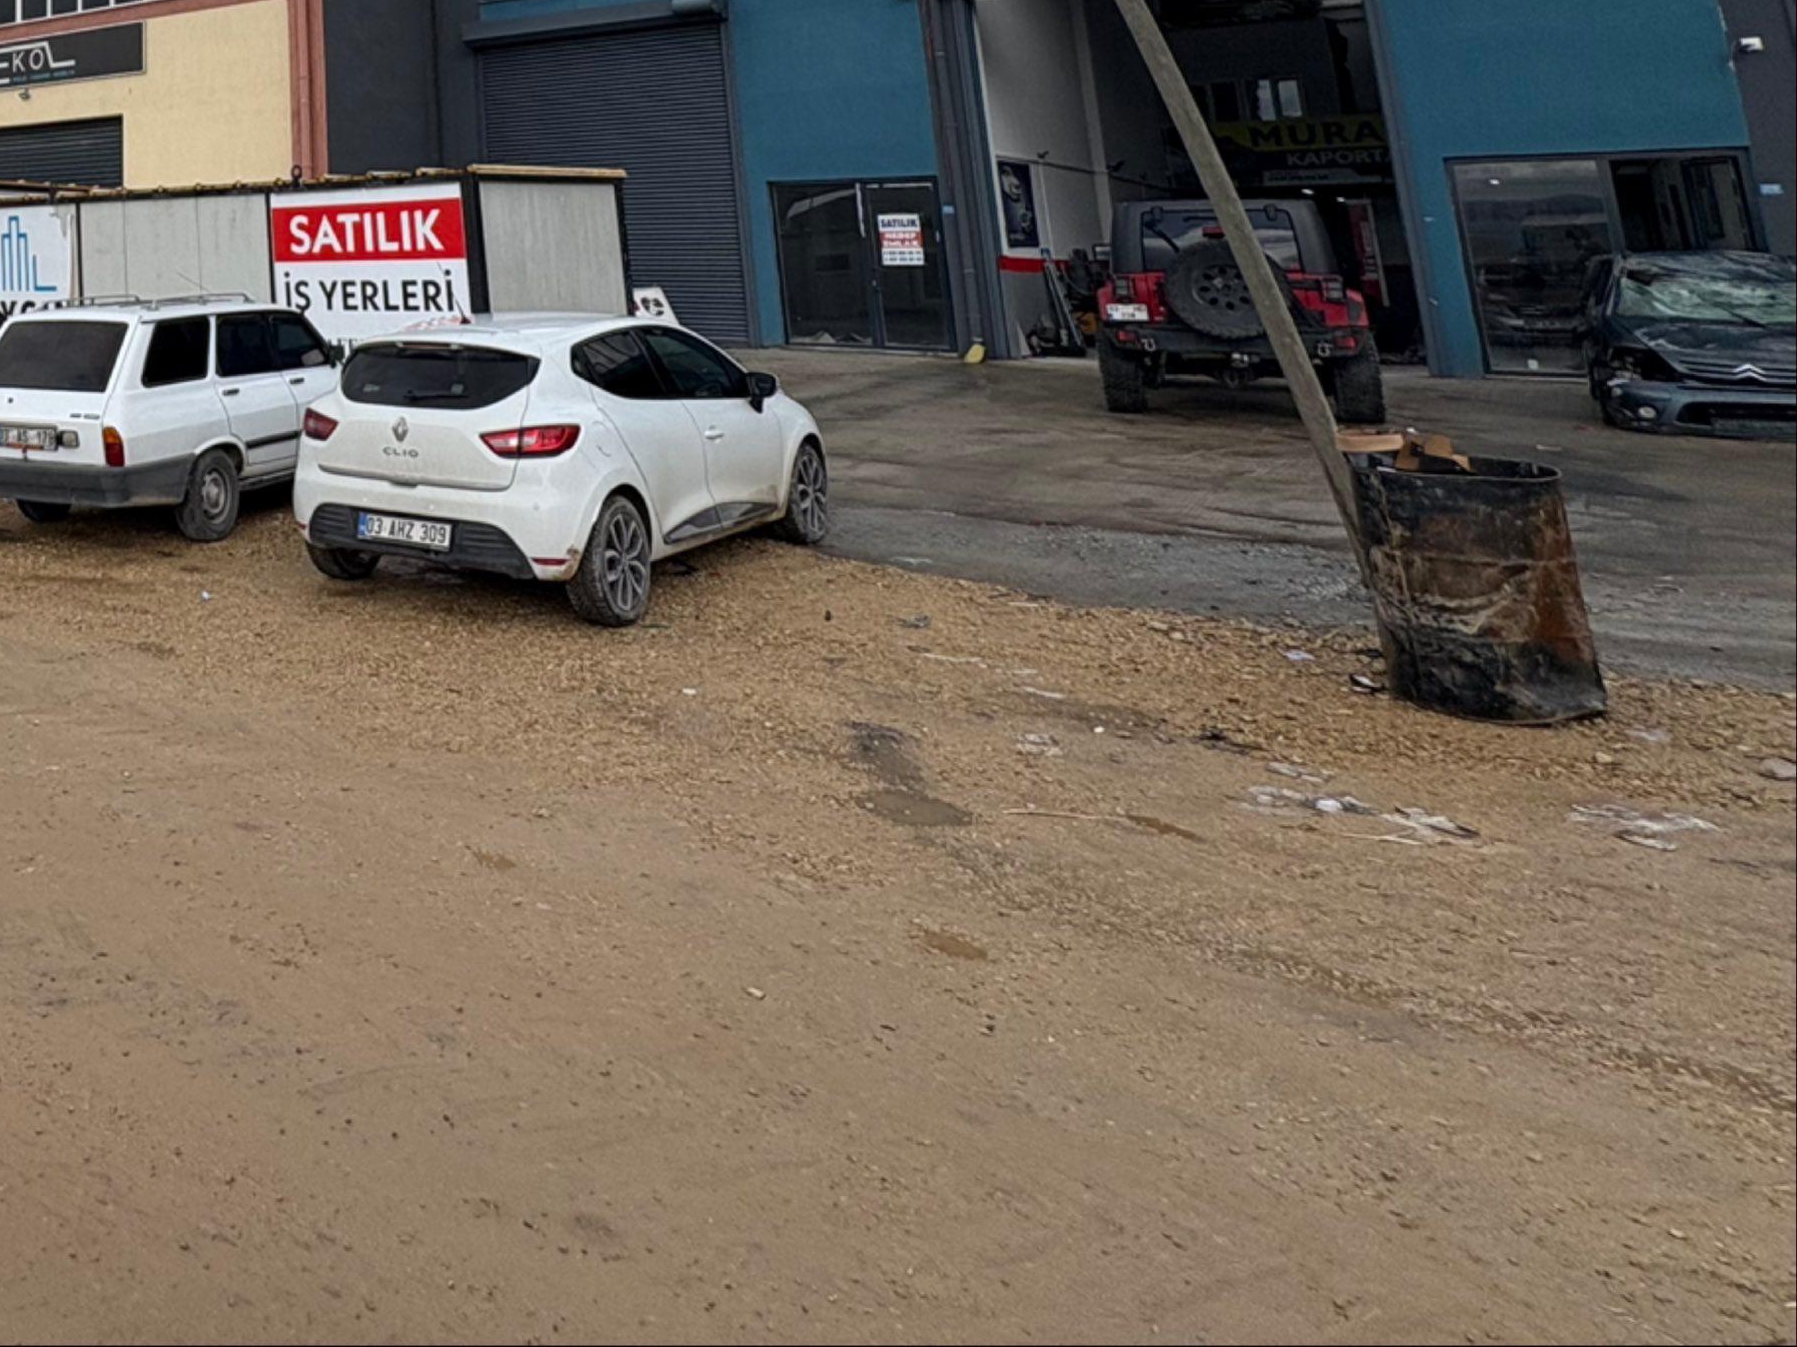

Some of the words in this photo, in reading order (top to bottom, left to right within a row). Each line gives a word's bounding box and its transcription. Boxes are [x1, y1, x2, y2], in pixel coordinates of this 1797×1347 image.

[289, 208, 445, 255] SATILIK
[318, 268, 454, 312] YERLERİ
[382, 446, 419, 458] CLIO
[367, 517, 383, 534] 03
[388, 520, 414, 539] AHZ
[420, 524, 446, 544] 309
